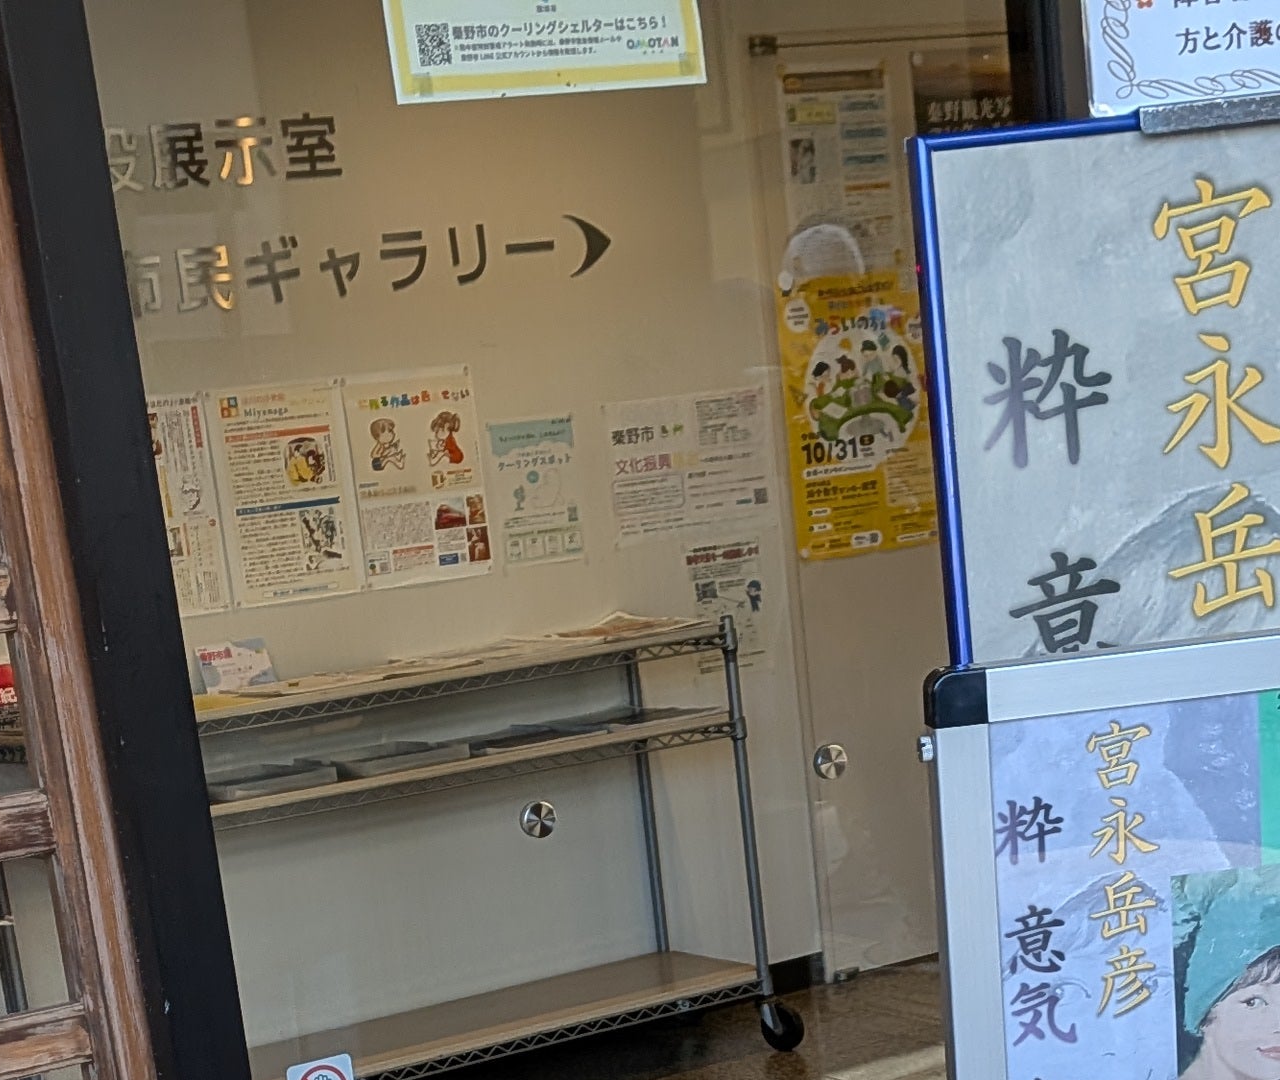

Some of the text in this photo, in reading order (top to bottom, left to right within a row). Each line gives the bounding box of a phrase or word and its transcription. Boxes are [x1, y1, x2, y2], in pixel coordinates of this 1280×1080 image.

[611, 425, 655, 447] 秦野市
[801, 436, 858, 465] 10/31
[1086, 720, 1160, 1020] 宮永岳彦
